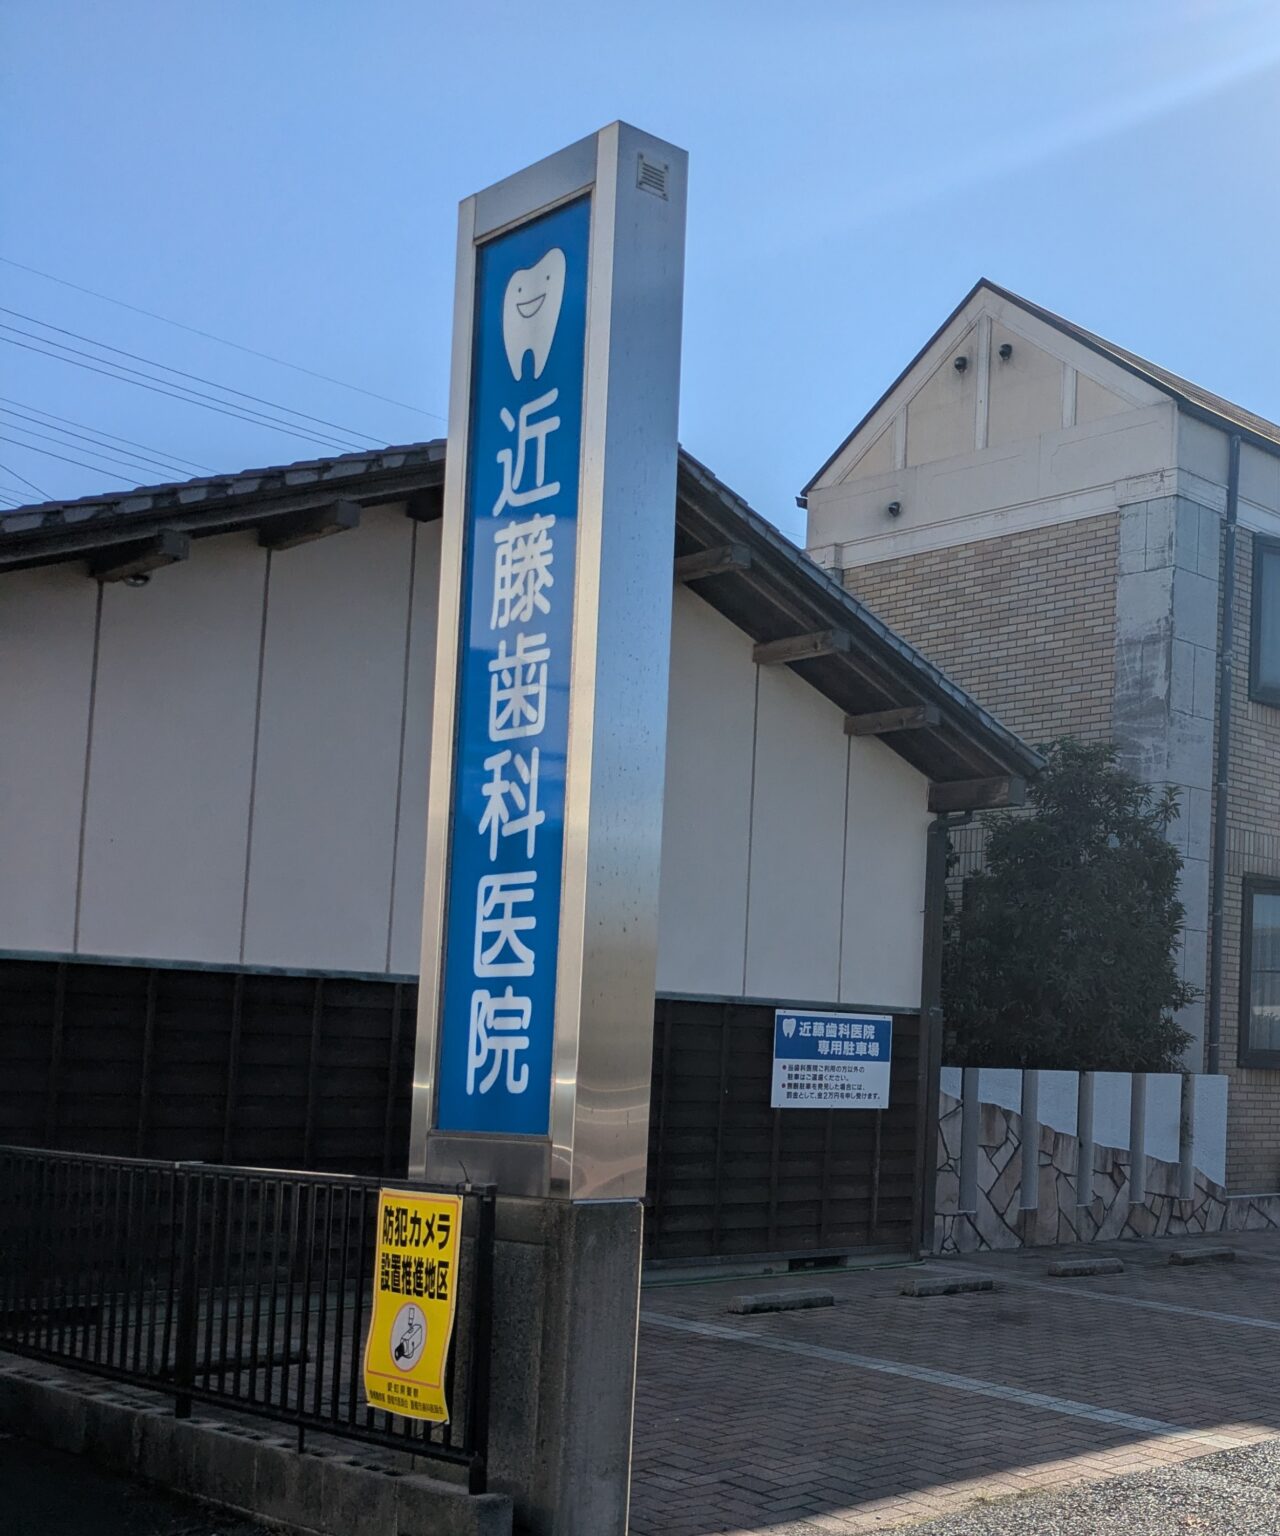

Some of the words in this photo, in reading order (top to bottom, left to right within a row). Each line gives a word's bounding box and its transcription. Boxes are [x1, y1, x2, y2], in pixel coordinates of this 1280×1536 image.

[465, 387, 561, 1096] 近藤歯科医院
[799, 1021, 875, 1039] 近藤歯科医院
[817, 1040, 880, 1057] 専用駐車場
[382, 1205, 451, 1251] 防犯カメラ
[380, 1252, 450, 1301] 設置推進地区
